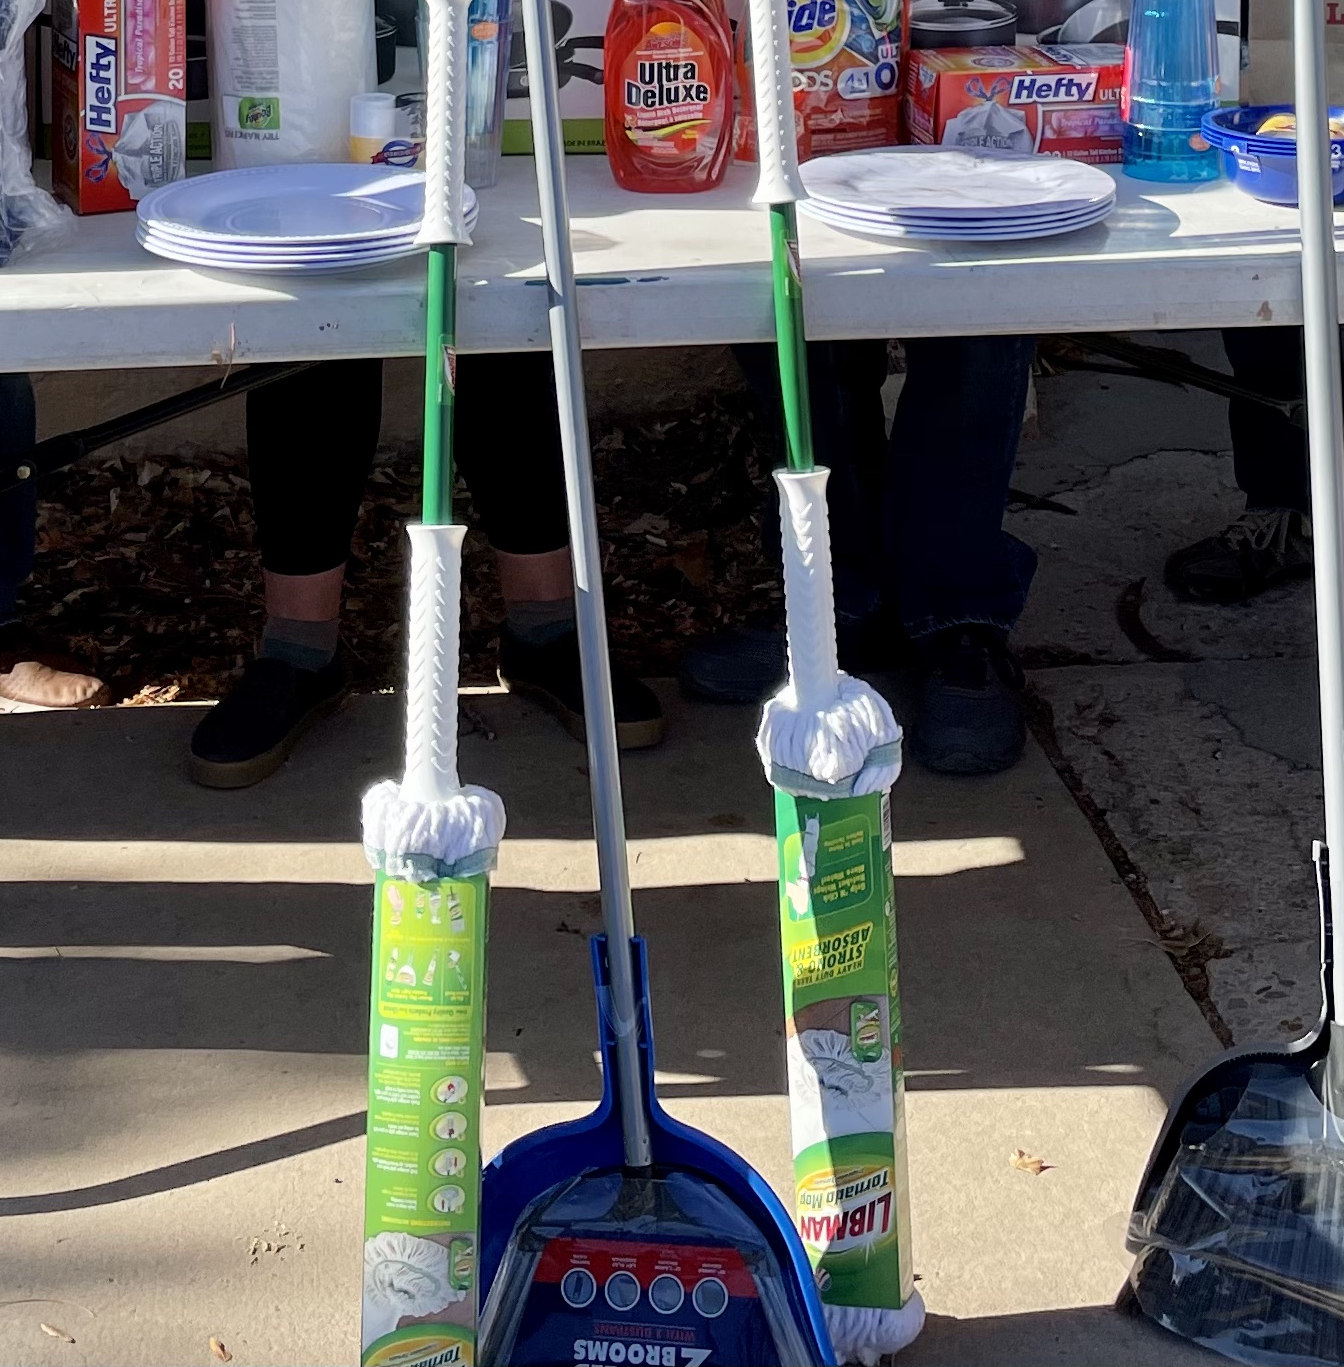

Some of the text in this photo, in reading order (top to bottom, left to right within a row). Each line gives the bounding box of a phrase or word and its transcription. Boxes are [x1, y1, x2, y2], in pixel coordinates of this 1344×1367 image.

[135, 37, 144, 73] Tropical
[89, 40, 117, 129] Hefty
[168, 68, 184, 91] 20
[639, 61, 696, 86] Ultra
[792, 69, 834, 92] ODS
[626, 80, 709, 108] Deluxe
[1014, 76, 1094, 102] Hefty
[791, 925, 870, 964] ABSORBENT
[807, 943, 863, 975] STRONG
[835, 959, 863, 976] HEAVY
[799, 1191, 823, 1209] Mop
[825, 1169, 889, 1206] Tornado
[800, 1191, 892, 1243] LIBMAN
[572, 1338, 677, 1367] BROOMS
